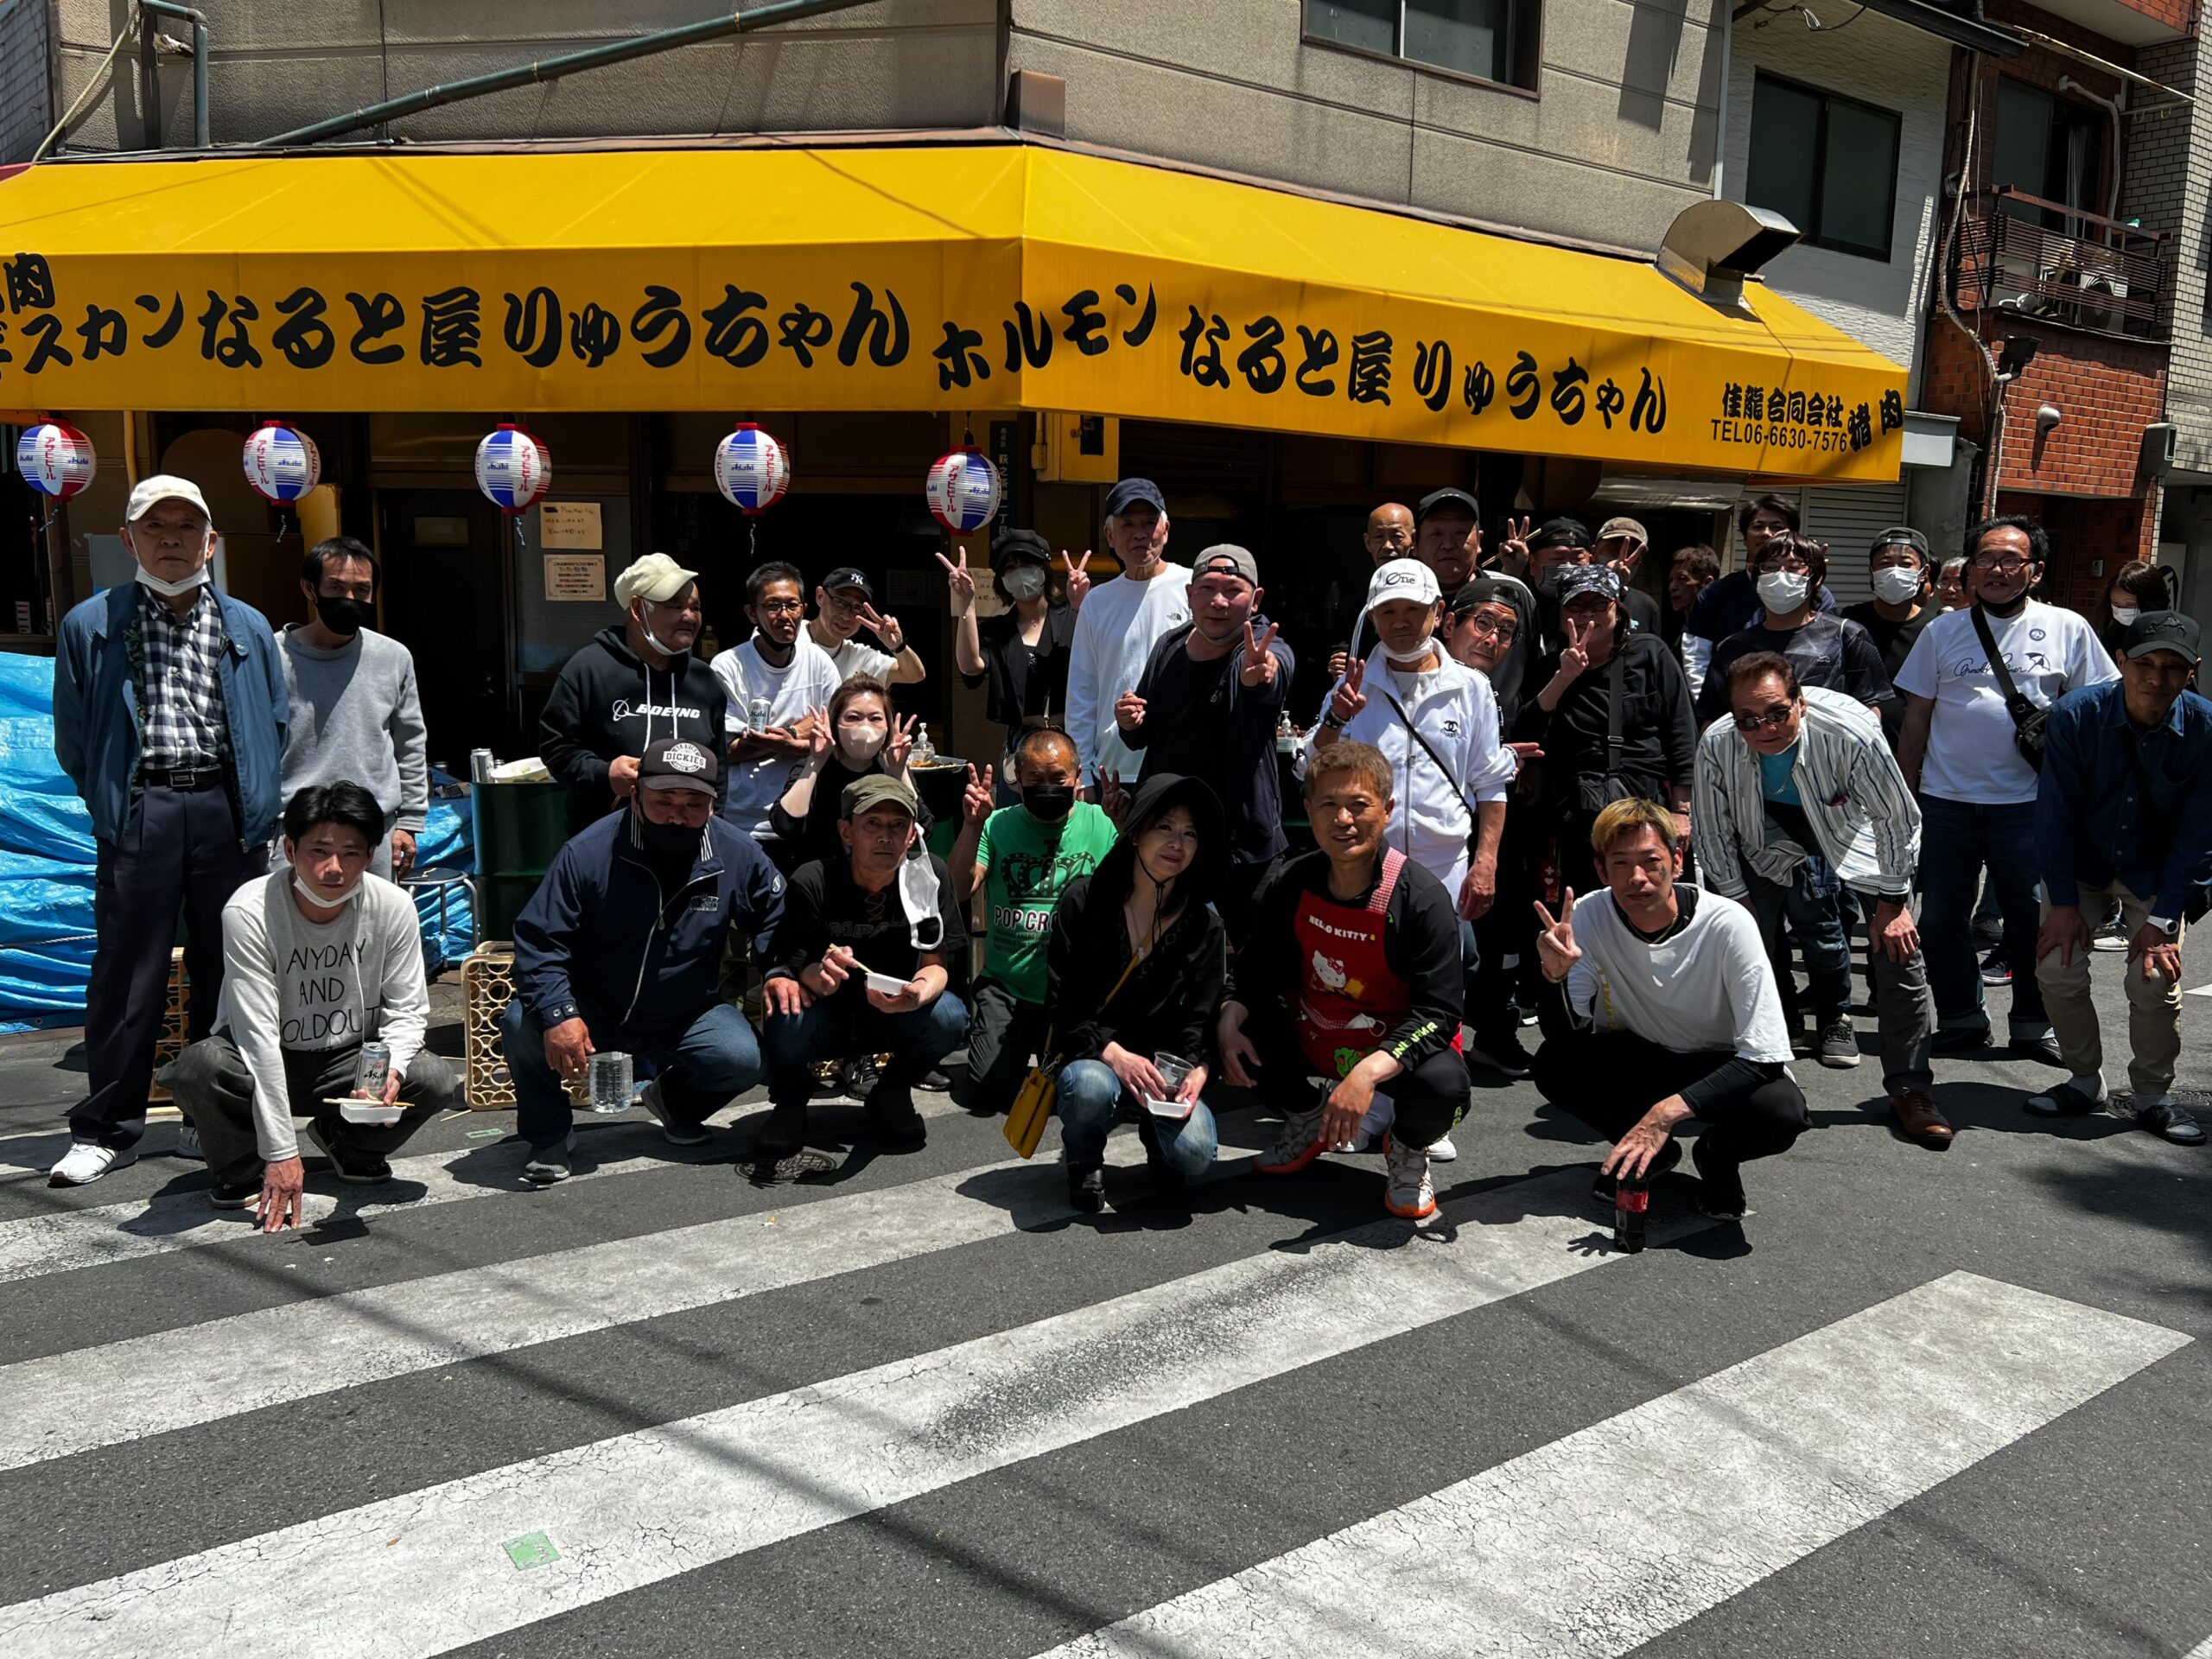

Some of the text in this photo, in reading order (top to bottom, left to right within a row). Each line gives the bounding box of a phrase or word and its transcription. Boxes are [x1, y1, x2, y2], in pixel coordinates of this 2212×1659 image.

[0, 252, 55, 315] 肉
[932, 282, 1157, 391] ホルモン
[1722, 381, 1844, 429] 佳龍合同会社
[1711, 418, 1847, 452] TEL06-6630-7576
[731, 463, 754, 472] Asahi
[763, 444, 775, 492] アサヒビール
[947, 465, 960, 513] アサヒビール
[636, 703, 701, 719] BOEING
[666, 753, 704, 766] DICKIES
[994, 905, 1023, 930] POP
[1333, 928, 1368, 942] KITTY
[286, 938, 366, 974] ANYDAY
[299, 977, 345, 1007] AND
[280, 1005, 380, 1044] OLDOUT
